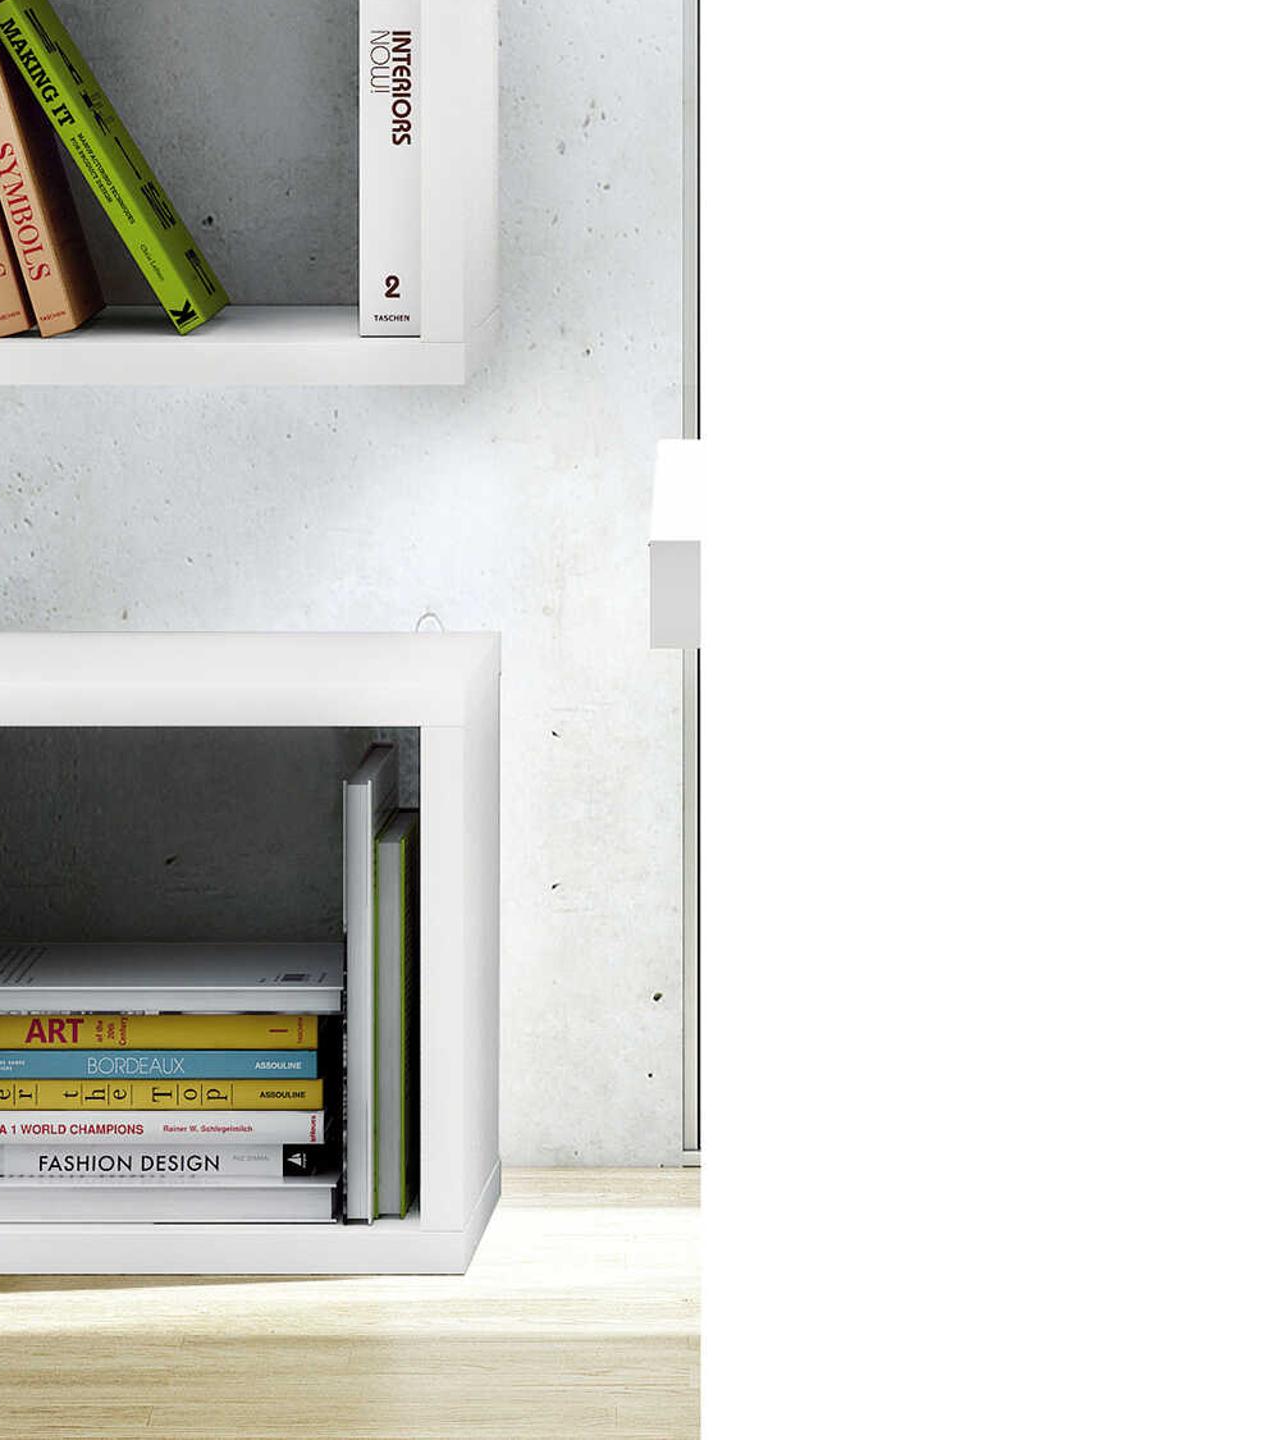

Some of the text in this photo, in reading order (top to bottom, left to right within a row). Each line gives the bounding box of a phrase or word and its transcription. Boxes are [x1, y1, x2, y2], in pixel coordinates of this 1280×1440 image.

[0, 16, 76, 128] MAKING IT
[391, 30, 412, 146] INTERIORS
[384, 275, 400, 299] 2
[374, 313, 410, 323] TASCHEN
[25, 1018, 84, 1043] ART
[87, 1057, 184, 1074] BORDEAUX
[255, 1061, 302, 1070] ASSOULINE
[63, 1088, 127, 1101] the
[152, 1087, 228, 1103] Top
[260, 1091, 306, 1099] ASSOULINE
[11, 1124, 17, 1135] 1
[21, 1124, 67, 1135] WORLD
[73, 1124, 144, 1135] CHAMPIONS
[40, 1155, 132, 1171] FASHION
[142, 1155, 219, 1171] DESIGN
